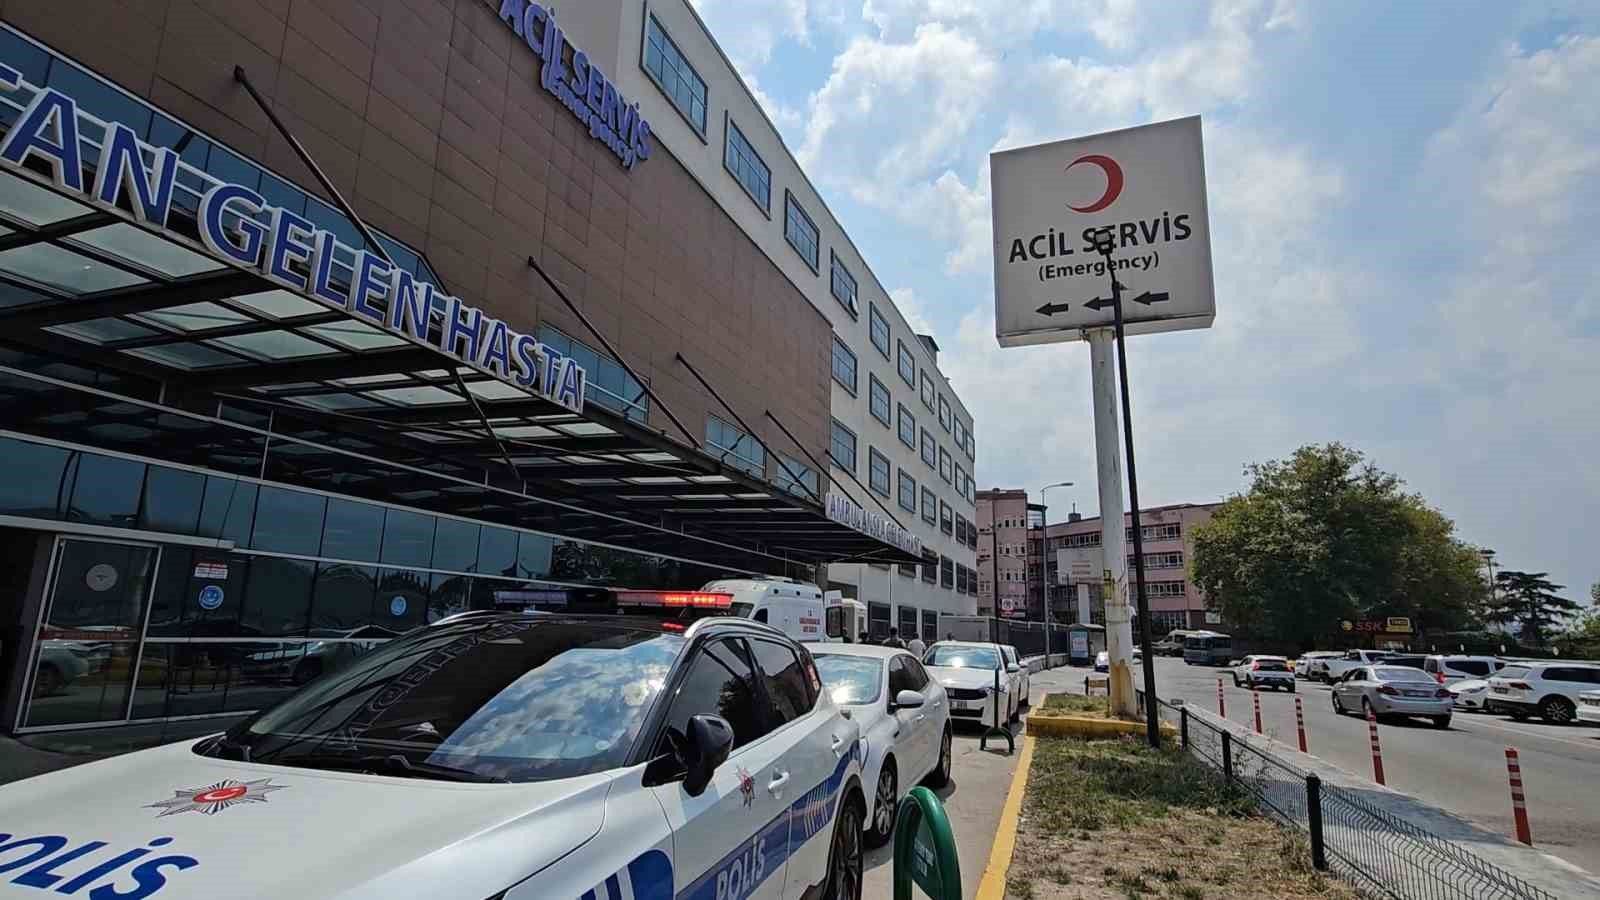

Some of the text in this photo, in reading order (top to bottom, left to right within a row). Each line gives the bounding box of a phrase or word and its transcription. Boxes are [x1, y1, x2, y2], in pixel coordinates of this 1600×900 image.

[571, 49, 651, 161] SERVİS
[1008, 228, 1074, 264] ACİL
[1038, 251, 1160, 282] (Emergency)
[197, 183, 434, 345] GELEN
[441, 296, 585, 414] HASTA
[0, 833, 199, 900] OLİS
[716, 834, 766, 900] POLİS
